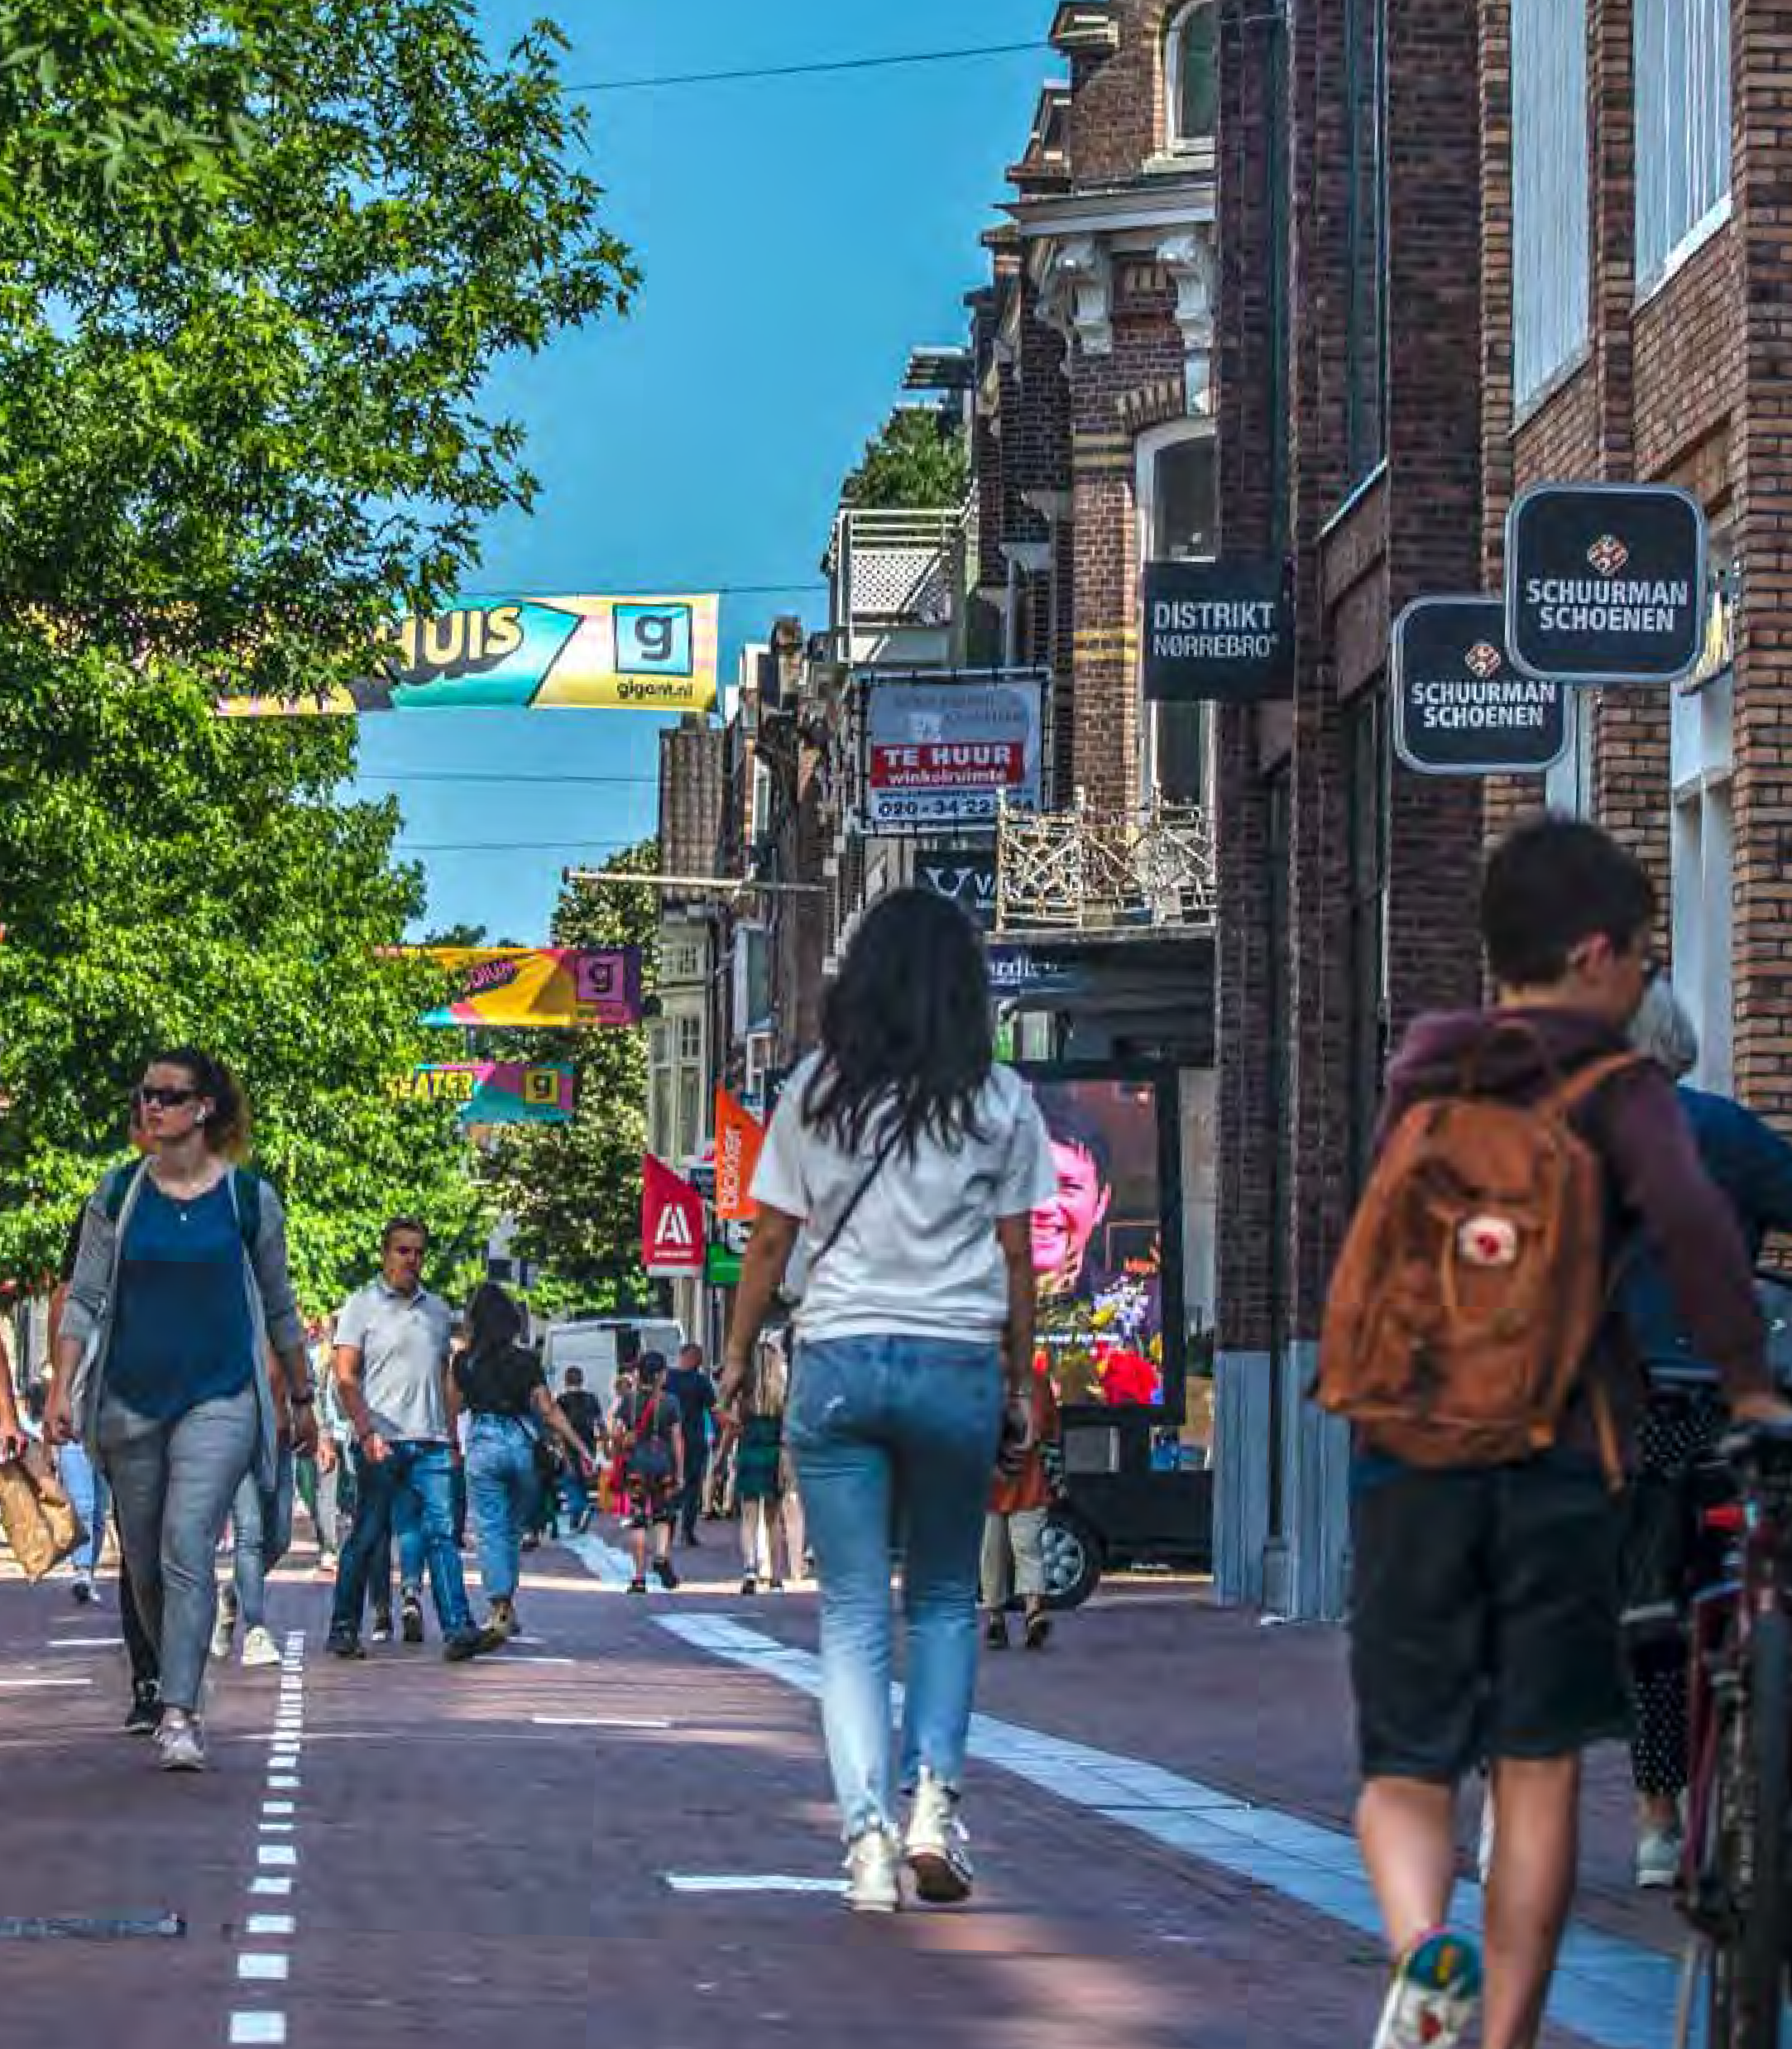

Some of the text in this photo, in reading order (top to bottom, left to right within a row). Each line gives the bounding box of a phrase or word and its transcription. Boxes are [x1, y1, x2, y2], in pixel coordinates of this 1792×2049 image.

[1526, 579, 1688, 606] SCHUURMAN
[1154, 601, 1276, 629] DISTRIKT
[1540, 607, 1675, 631] SCHOENEN
[1411, 681, 1556, 704] SCHUURMAN
[1424, 705, 1543, 728] SCHOENEN
[884, 746, 1011, 767] TE HUUR
